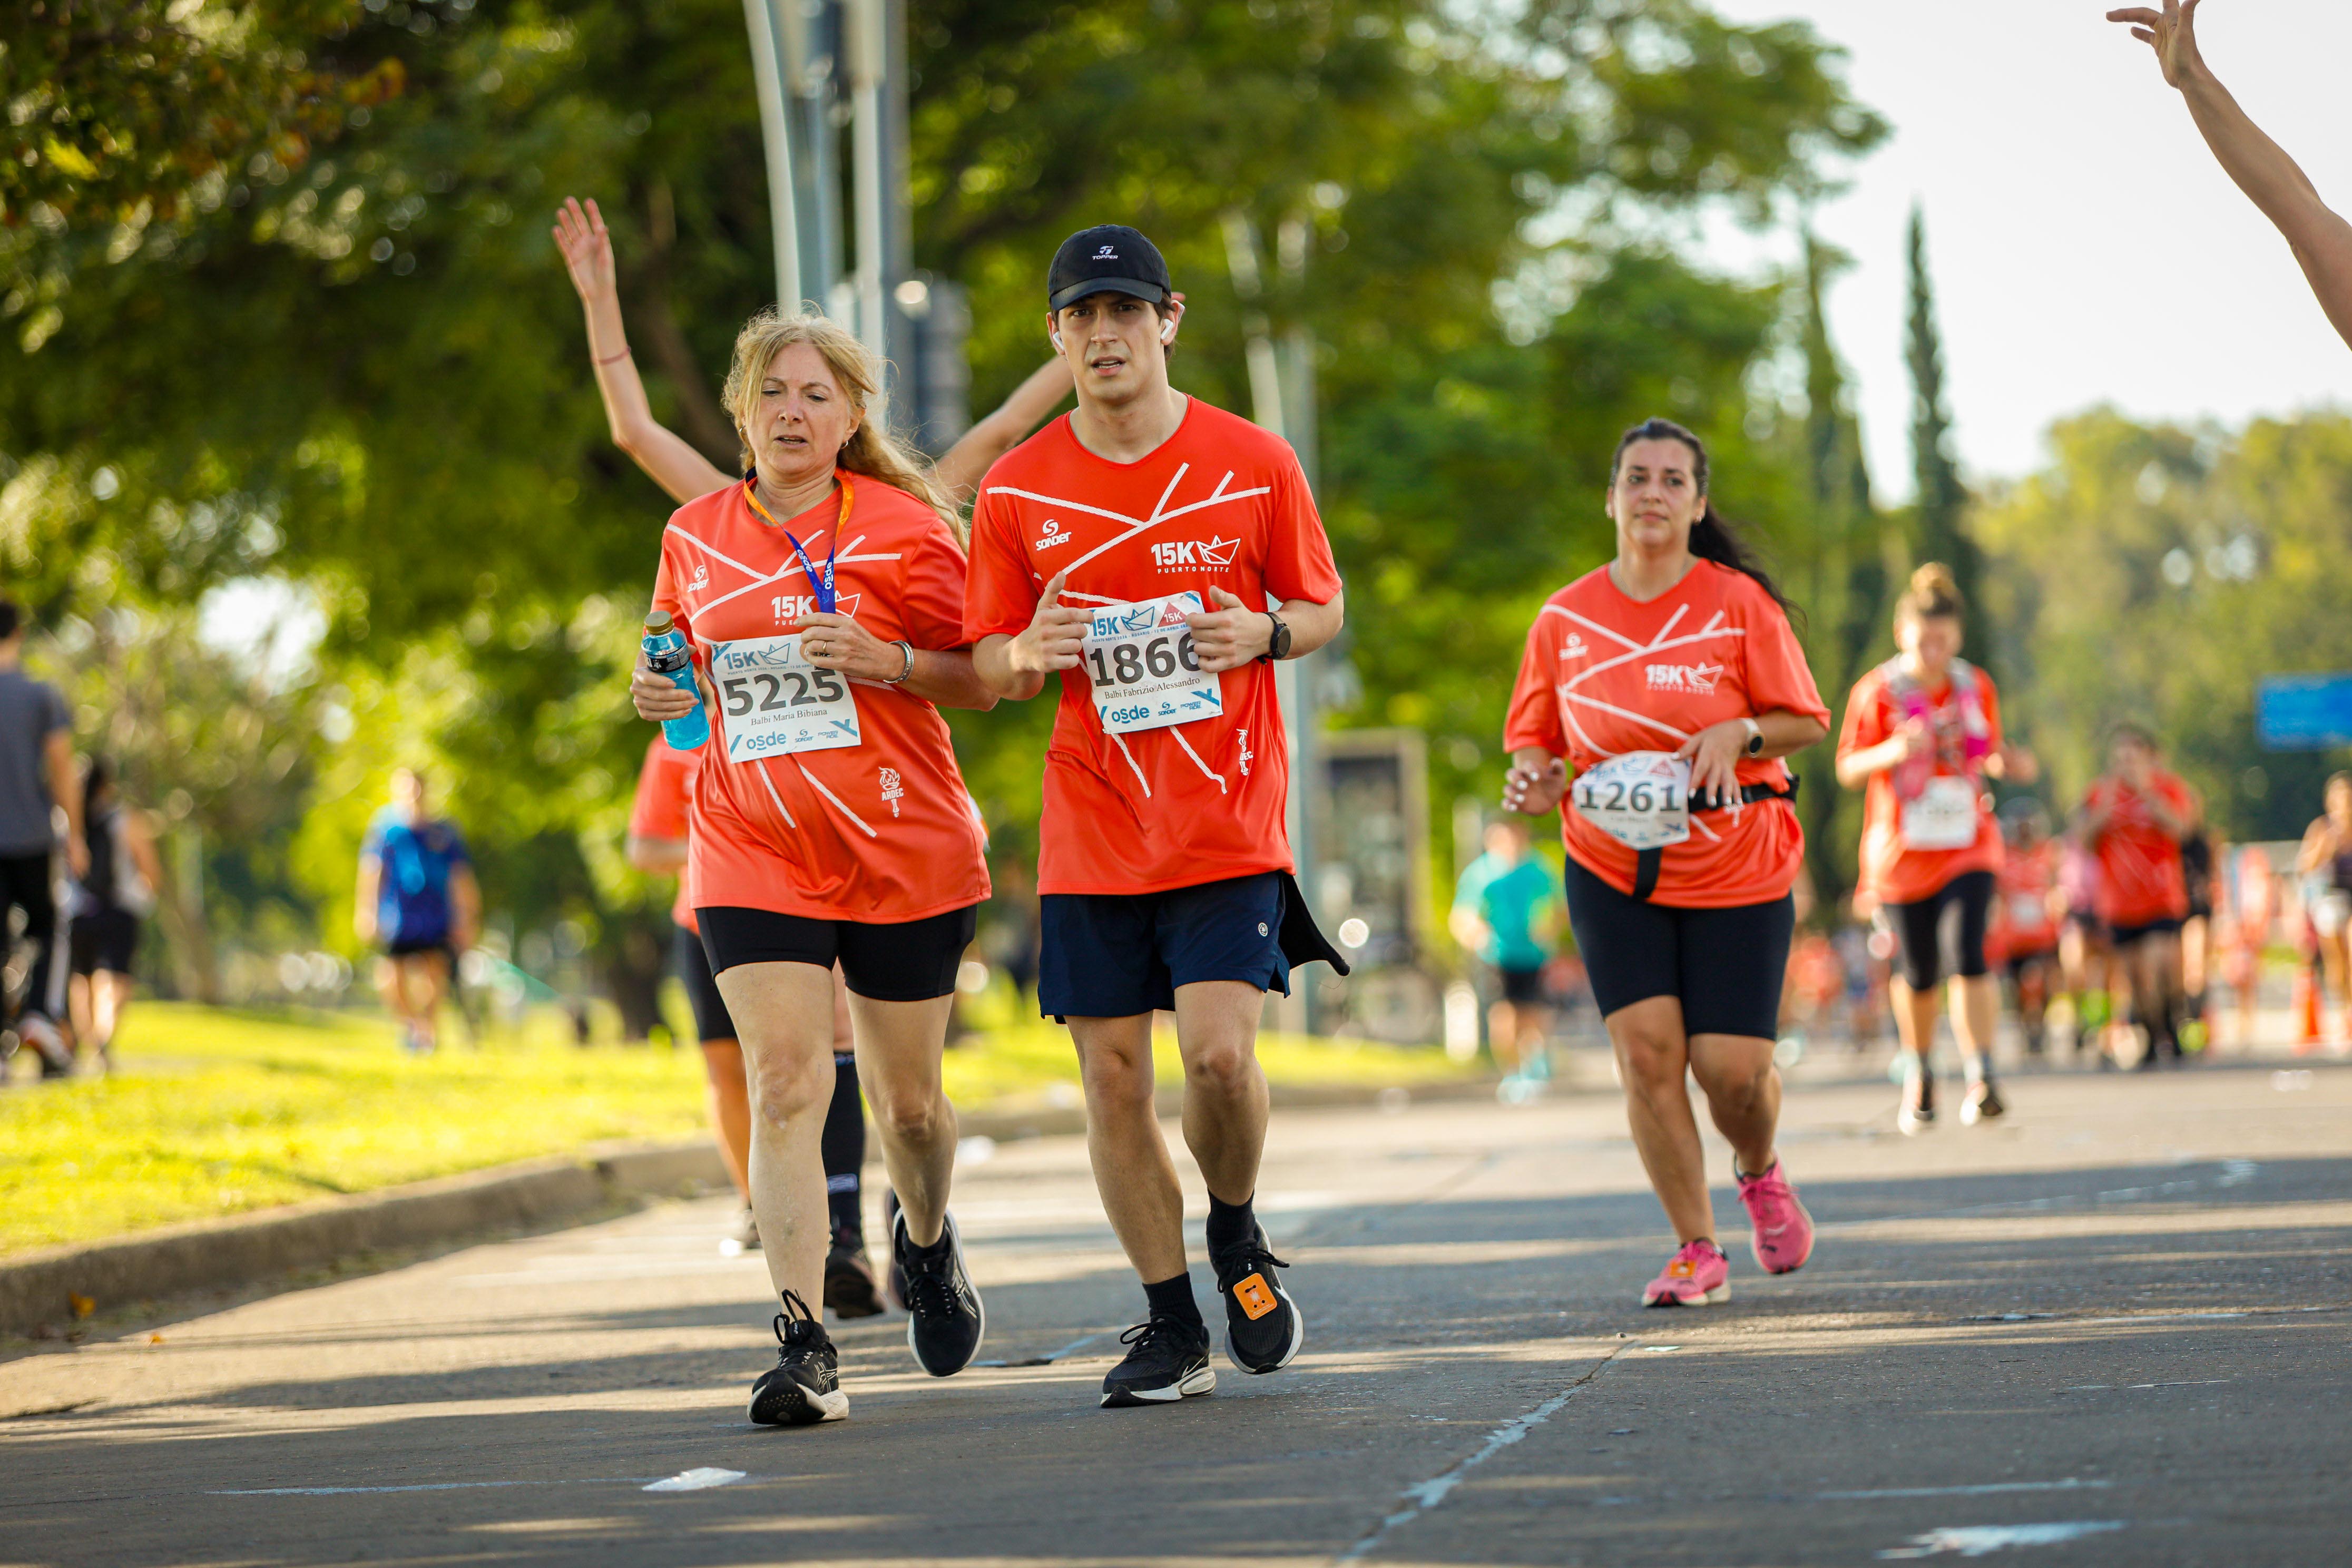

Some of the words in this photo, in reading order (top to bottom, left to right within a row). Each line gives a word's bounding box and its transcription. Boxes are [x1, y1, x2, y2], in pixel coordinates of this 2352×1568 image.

[797, 549, 813, 573] osde
[1151, 541, 1197, 566] 15K
[824, 561, 834, 590] osde
[771, 595, 816, 618] 15K
[1164, 611, 1183, 623] 15K
[1090, 616, 1120, 636] 15K
[723, 651, 759, 670] 15K
[1090, 632, 1201, 687] 1866
[1645, 664, 1684, 685] 15K
[723, 670, 844, 717] 5225
[1104, 690, 1122, 699] Balbi
[1123, 685, 1154, 697] Fabrizio
[1157, 678, 1200, 691] Alessandro
[751, 714, 771, 726] Balbi
[773, 711, 795, 722] Maria
[797, 709, 828, 718] Bibiana
[1111, 704, 1150, 724] osde
[747, 730, 787, 750] osde
[881, 788, 904, 801] ARDEC
[1581, 780, 1681, 812] 1261
